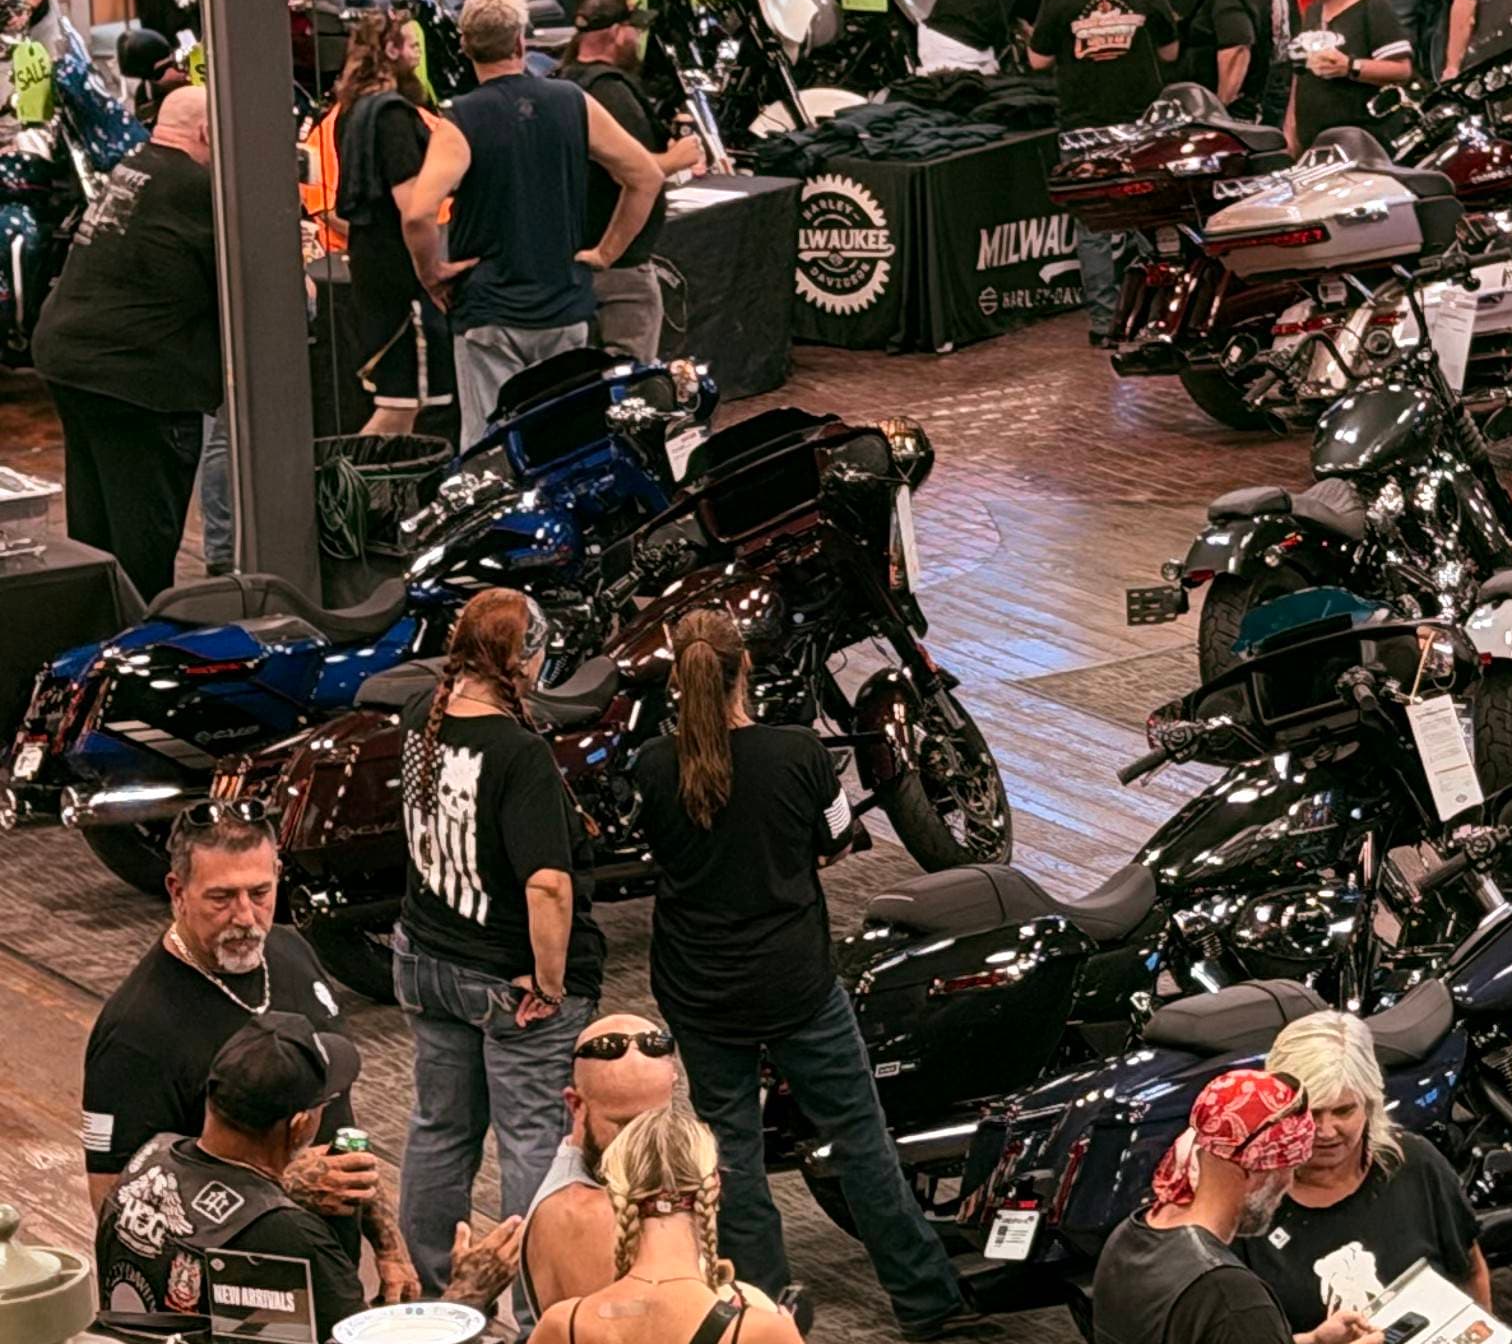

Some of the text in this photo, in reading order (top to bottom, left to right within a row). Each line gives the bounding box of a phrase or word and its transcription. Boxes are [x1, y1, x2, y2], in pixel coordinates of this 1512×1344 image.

[17, 59, 49, 91] SALE
[798, 228, 890, 249] LWAUKEE
[976, 213, 1078, 270] MILWAU
[213, 1284, 295, 1312] NEW ARRIVALS
